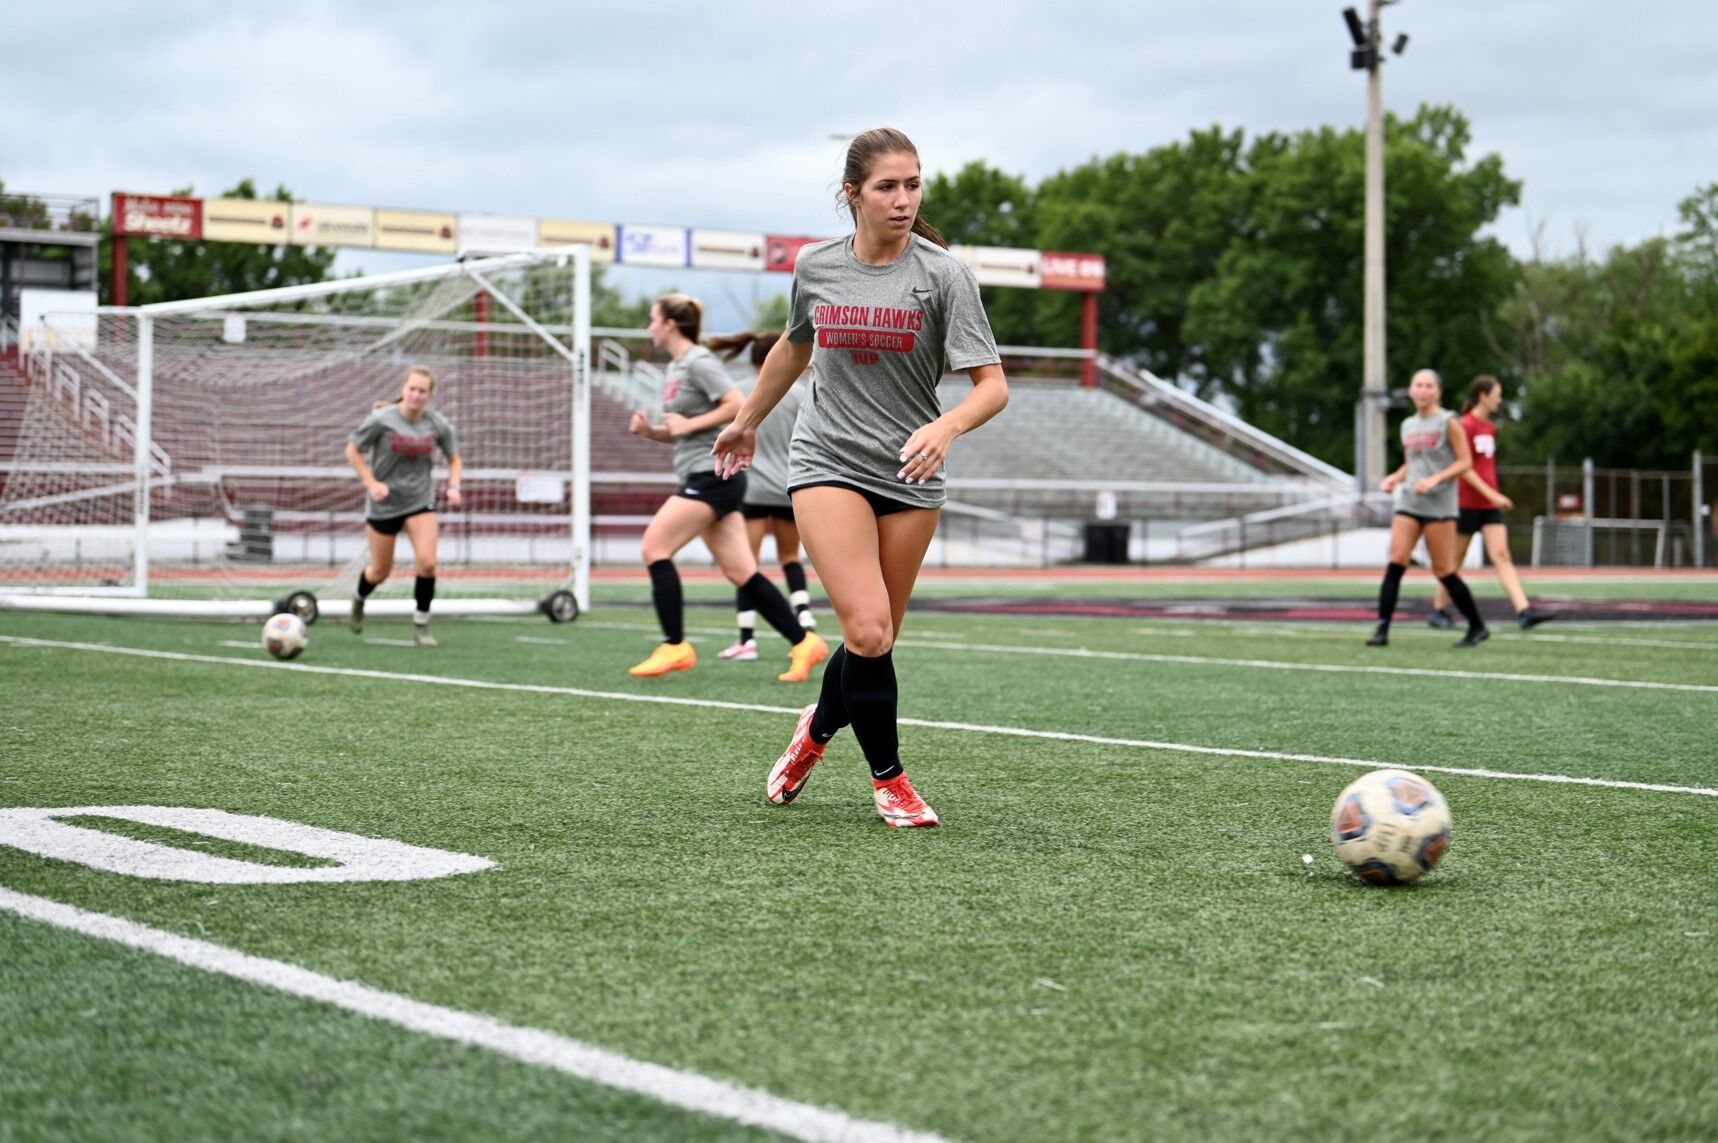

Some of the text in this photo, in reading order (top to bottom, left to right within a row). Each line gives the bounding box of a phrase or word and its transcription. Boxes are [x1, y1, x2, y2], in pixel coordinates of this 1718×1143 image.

[815, 305, 924, 330] CRIMSON HAWKS
[825, 331, 903, 349] WOMEN'S SOCCER
